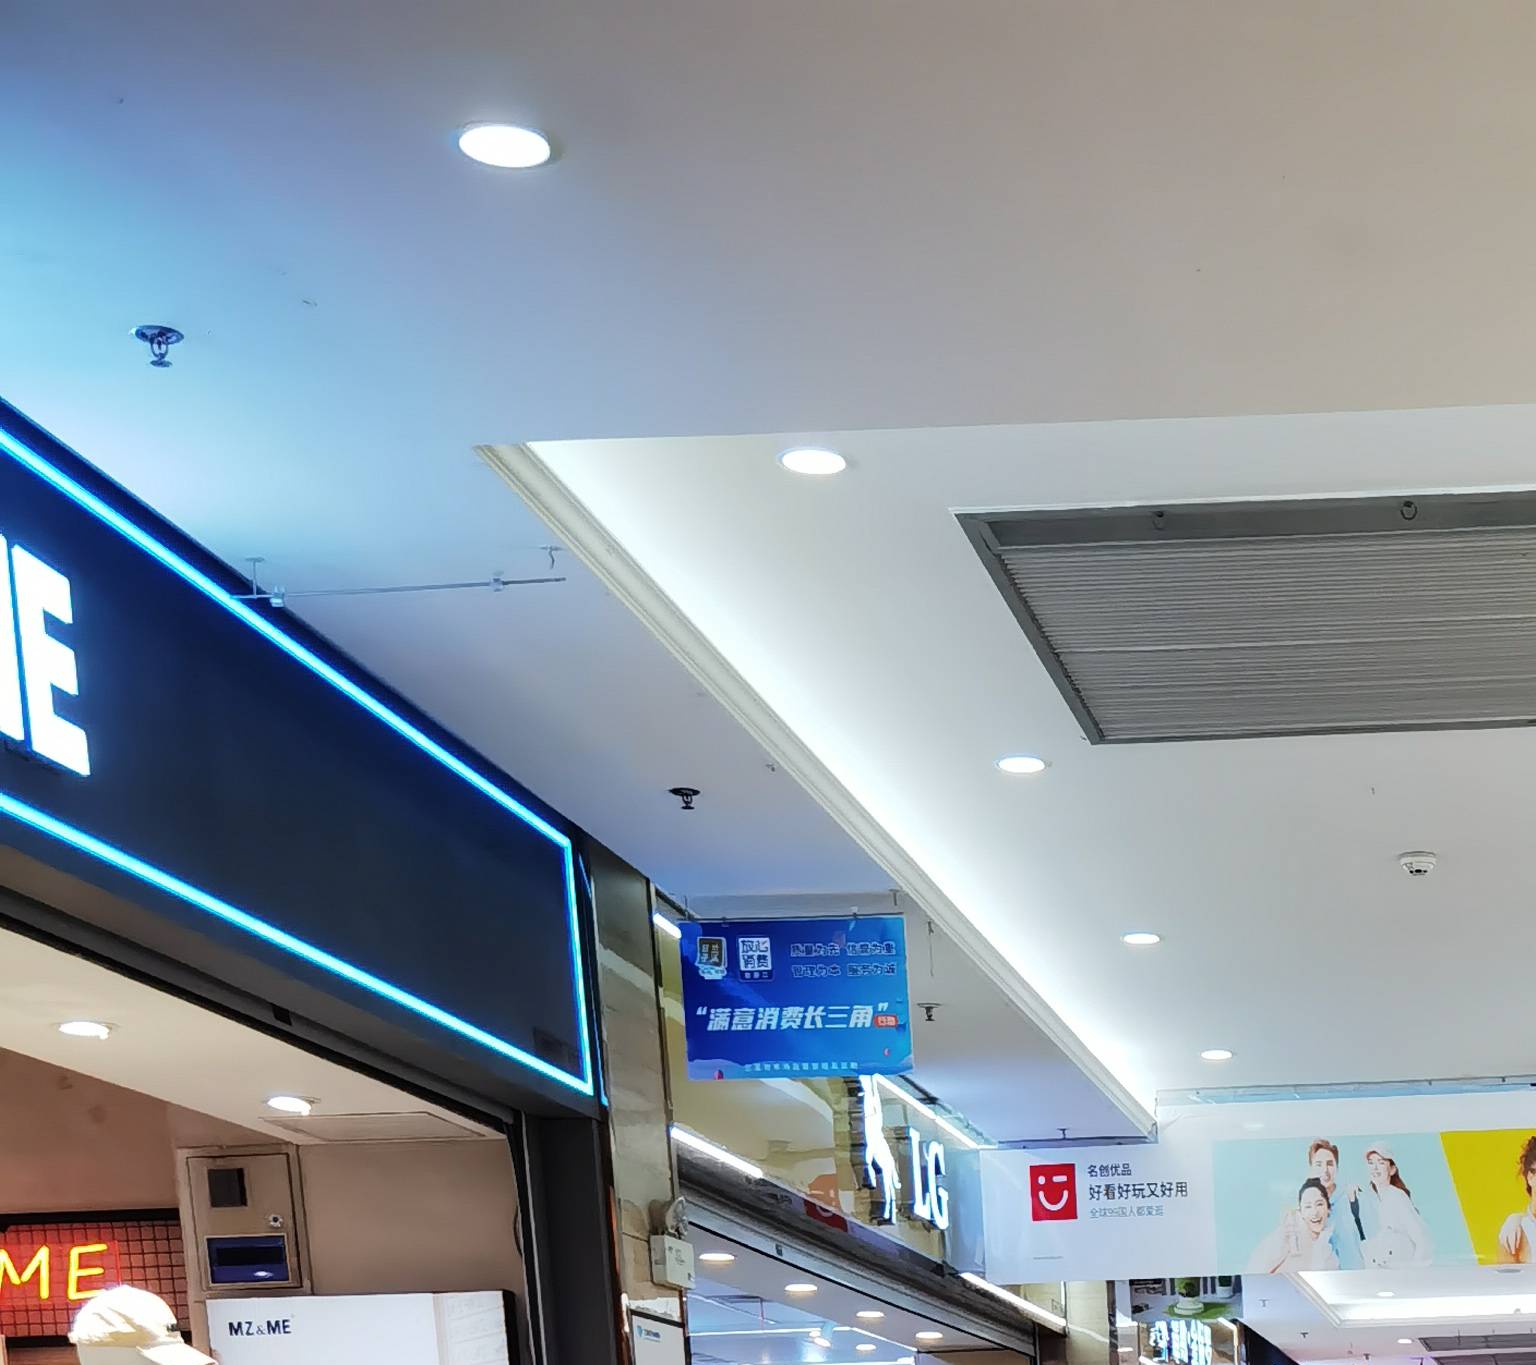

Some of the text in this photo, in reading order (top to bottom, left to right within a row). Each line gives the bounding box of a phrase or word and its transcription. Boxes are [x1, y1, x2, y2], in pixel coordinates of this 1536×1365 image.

[0, 534, 92, 777] E
[1087, 1163, 1132, 1178] 名创优品
[1089, 1181, 1188, 1201] 好看好玩又好用
